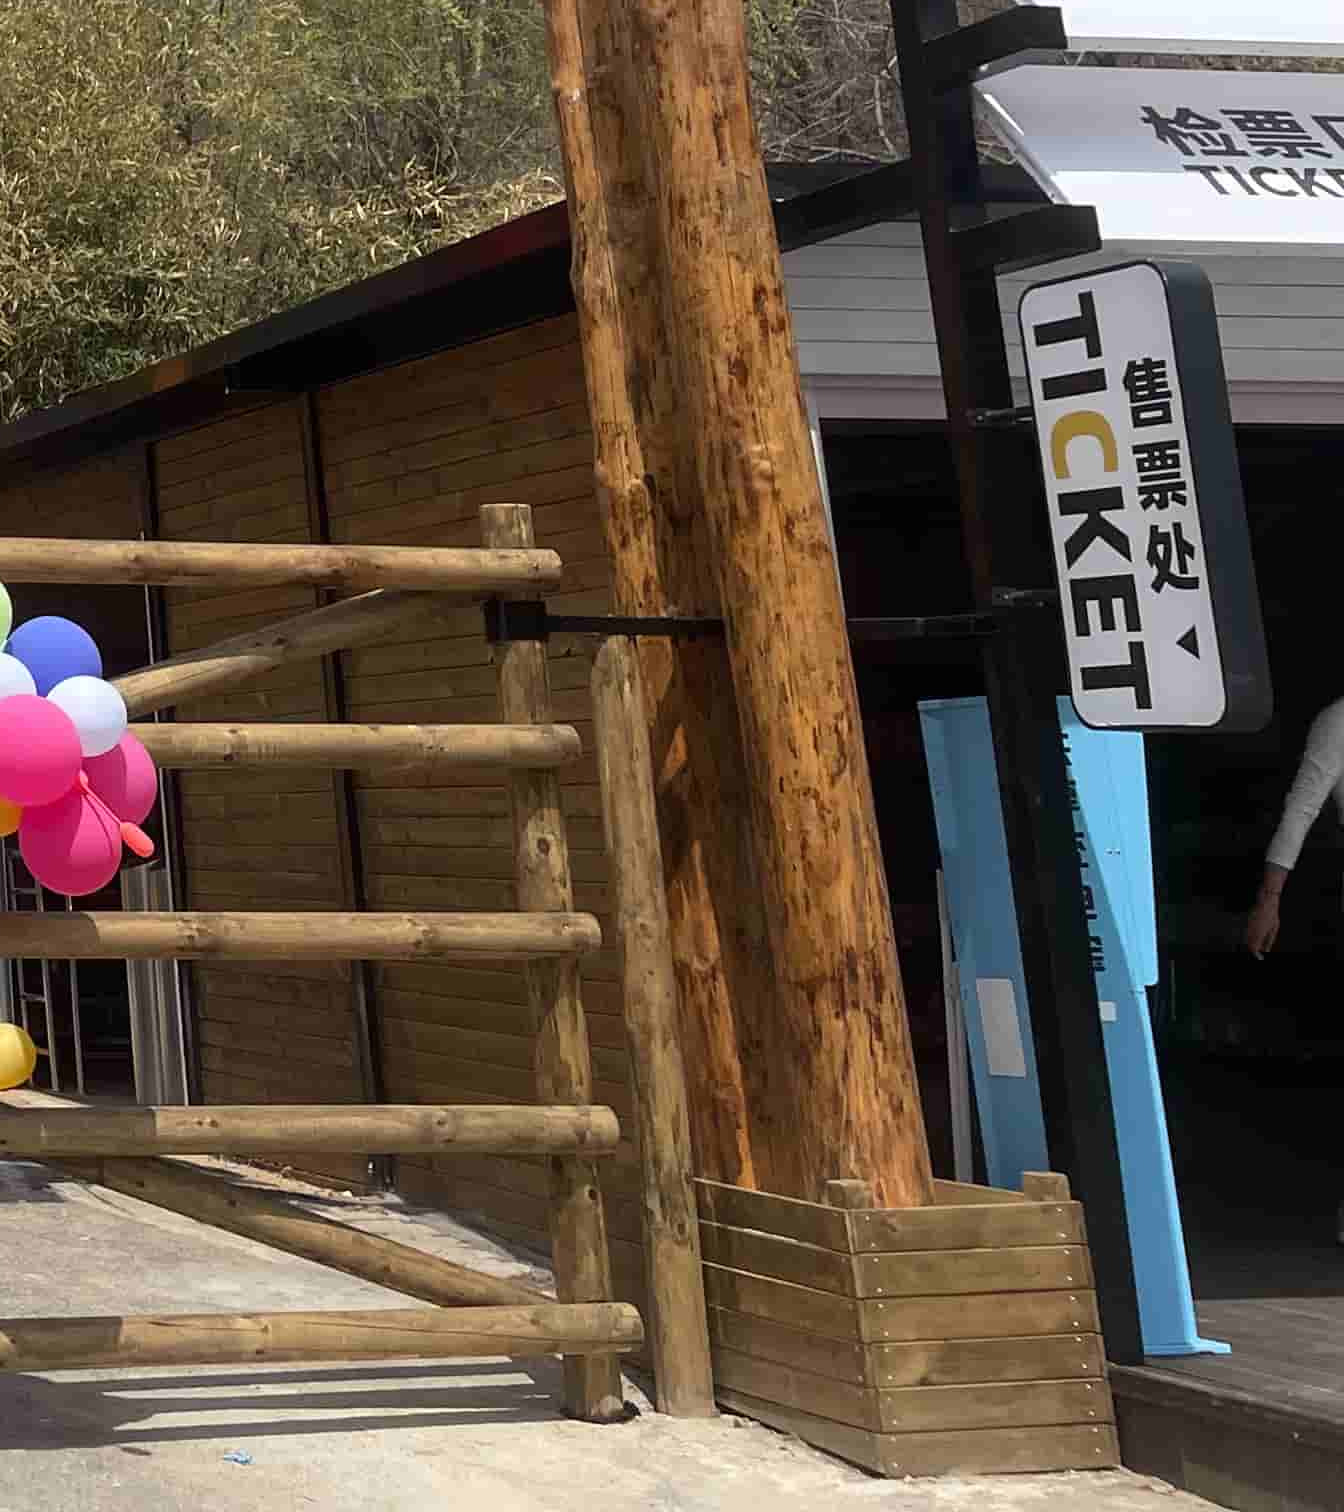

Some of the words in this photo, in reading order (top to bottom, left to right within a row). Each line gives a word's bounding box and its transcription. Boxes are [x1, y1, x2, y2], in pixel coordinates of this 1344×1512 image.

[1032, 290, 1153, 711] TICKET
[1122, 356, 1201, 595] 售票处
